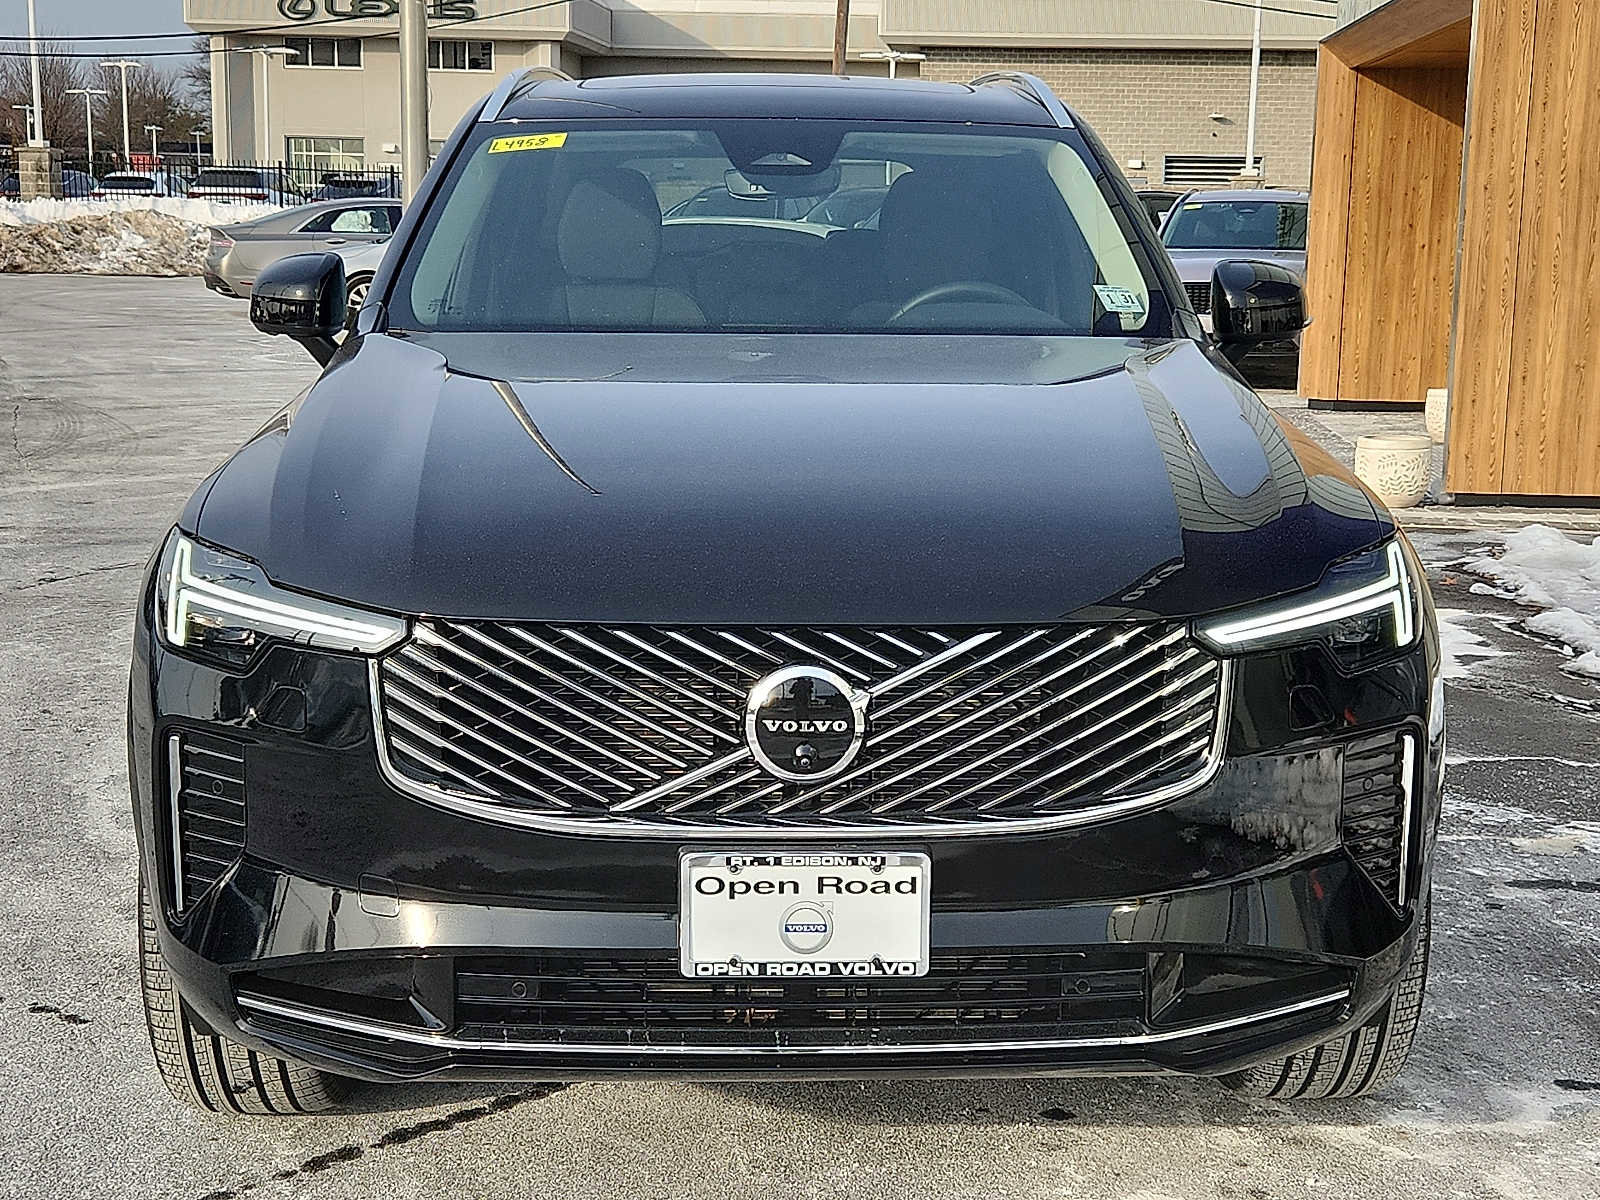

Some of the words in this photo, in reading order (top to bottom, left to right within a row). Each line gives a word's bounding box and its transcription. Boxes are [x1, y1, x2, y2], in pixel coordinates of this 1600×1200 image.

[1121, 294, 1135, 304] 31
[762, 720, 848, 732] VOLVO
[766, 857, 774, 866] 1
[858, 857, 881, 866] NJ
[695, 876, 799, 900] Open
[817, 876, 917, 895] Road
[696, 963, 759, 976] OPEN
[766, 963, 831, 976] ROAD
[838, 963, 915, 976] VOLVO
